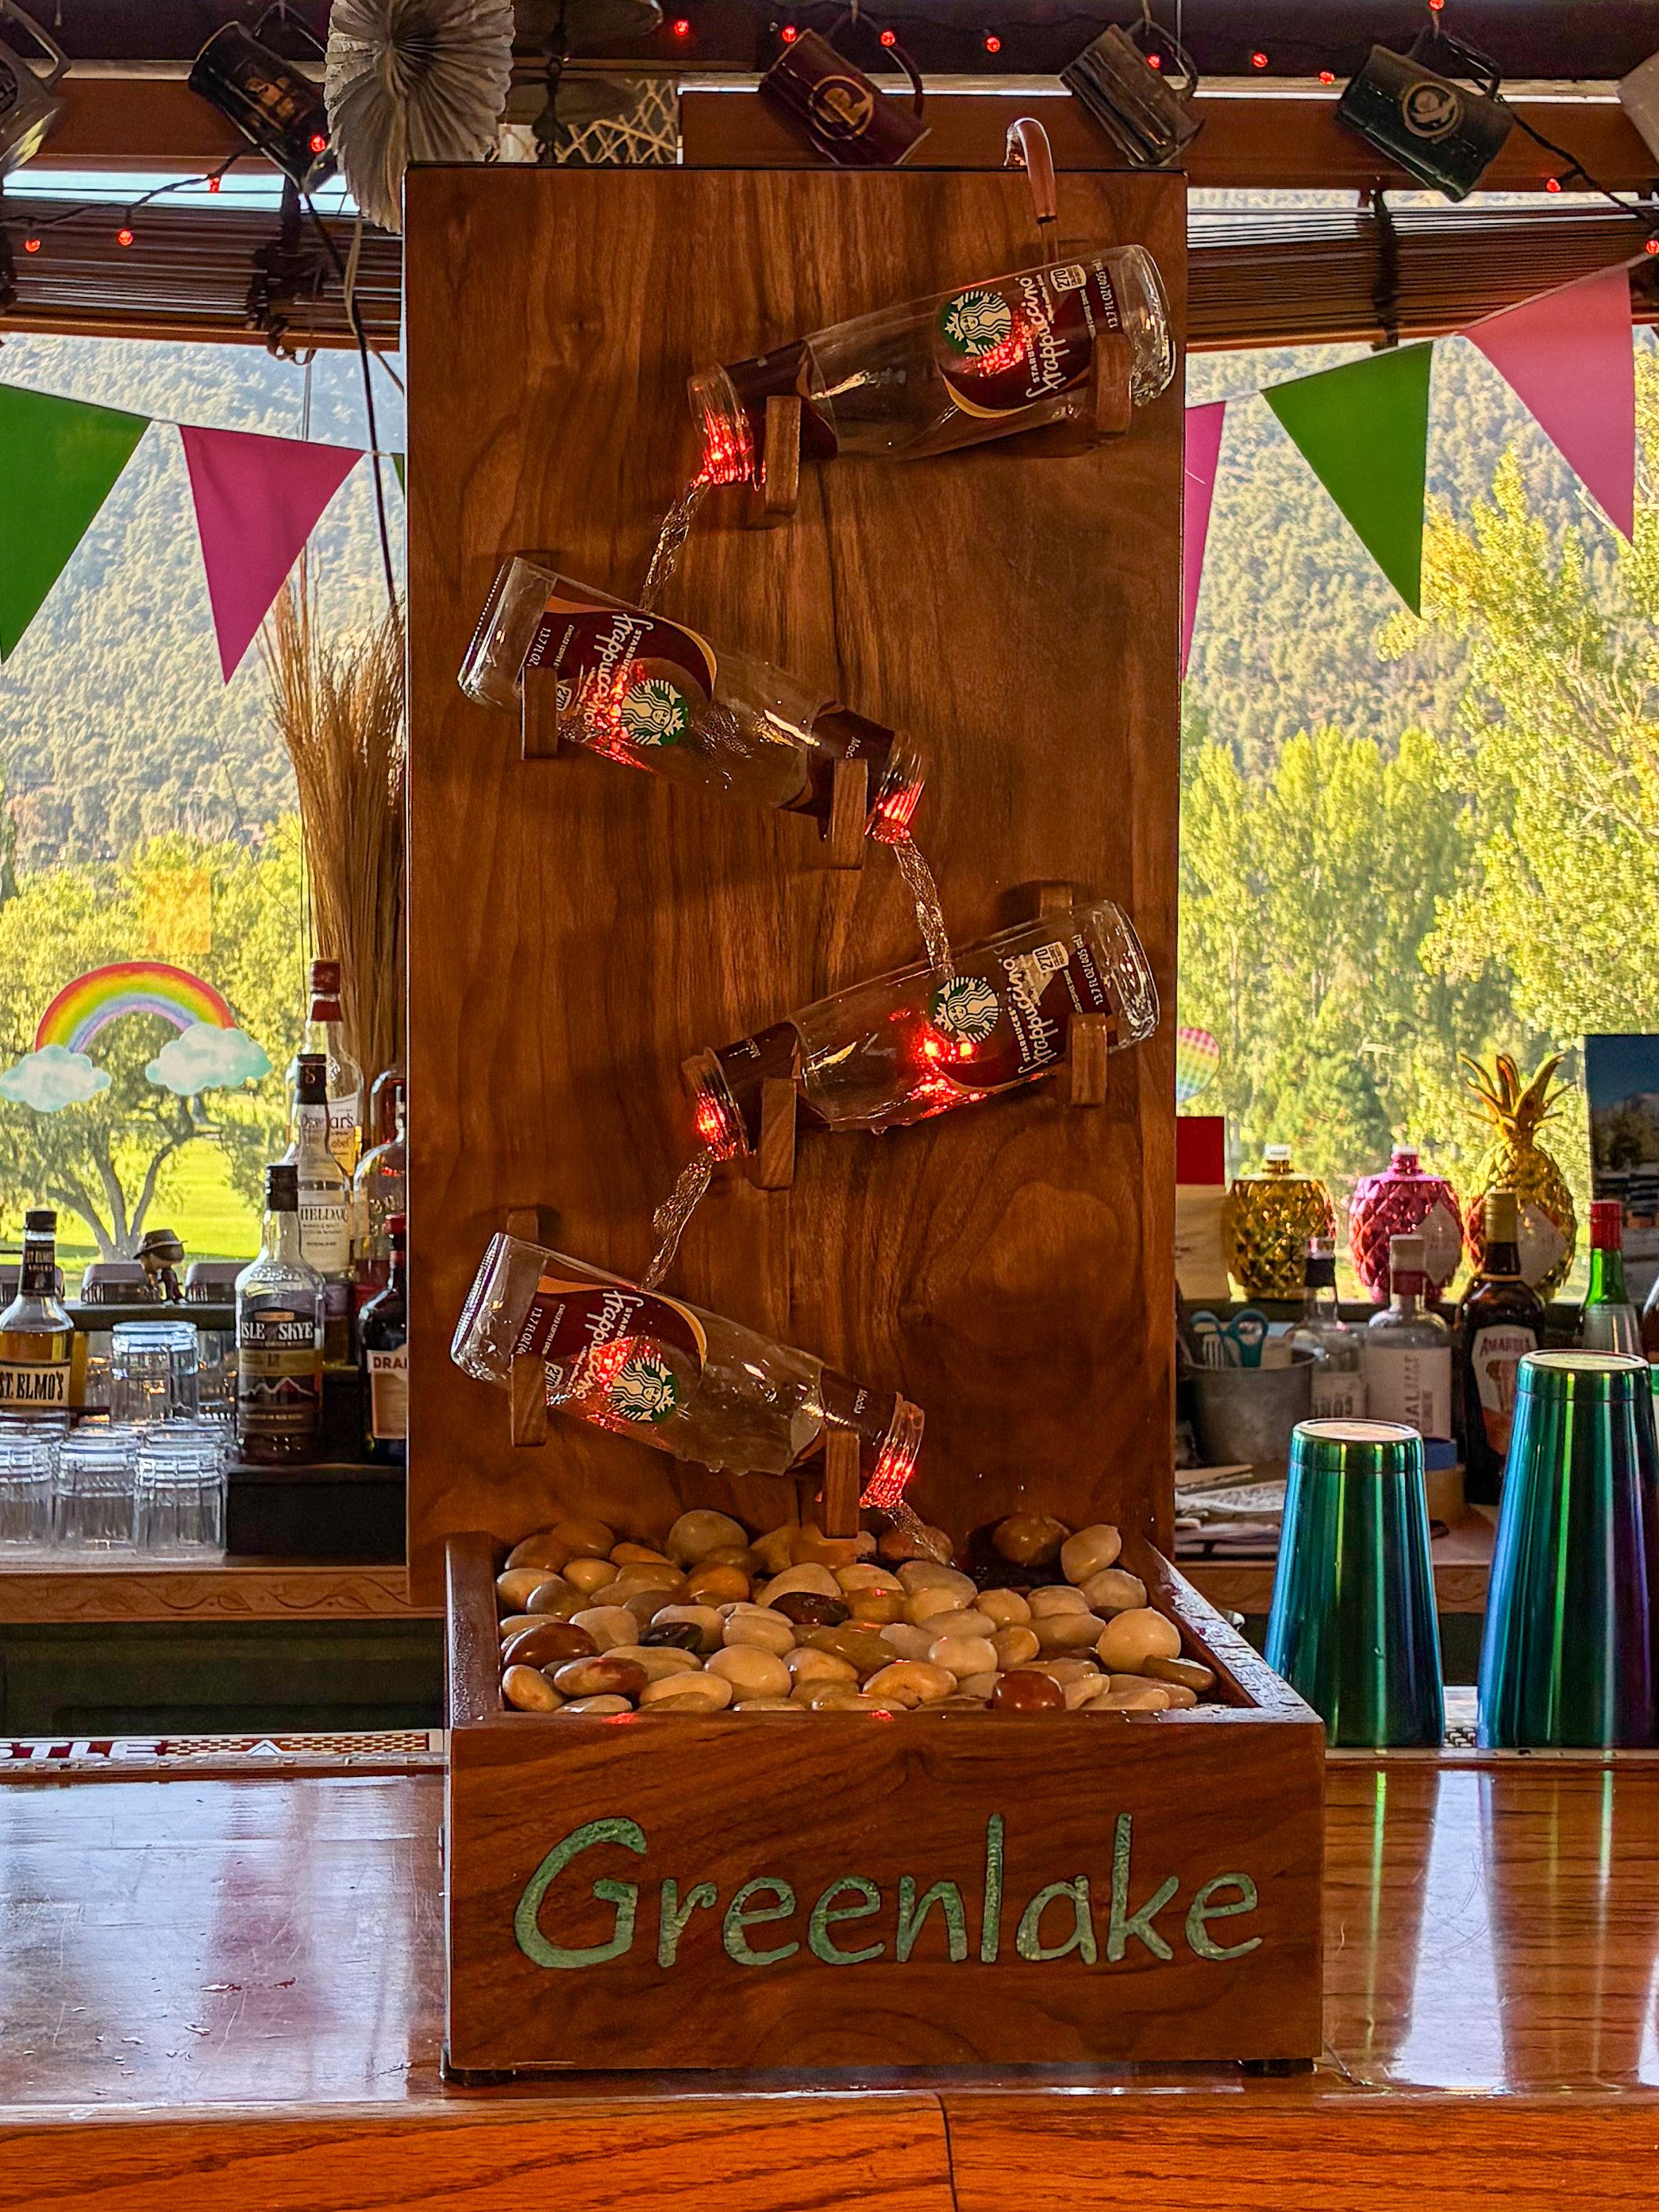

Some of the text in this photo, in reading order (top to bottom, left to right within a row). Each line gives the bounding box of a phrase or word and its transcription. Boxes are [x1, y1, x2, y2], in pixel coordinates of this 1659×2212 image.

[1053, 268, 1070, 289] 270
[1034, 948, 1053, 970] 270
[1009, 1008, 1030, 1062] STARBUCKS
[17, 1370, 64, 1400] ELMO'S
[513, 1813, 1263, 1970] Greenlake
